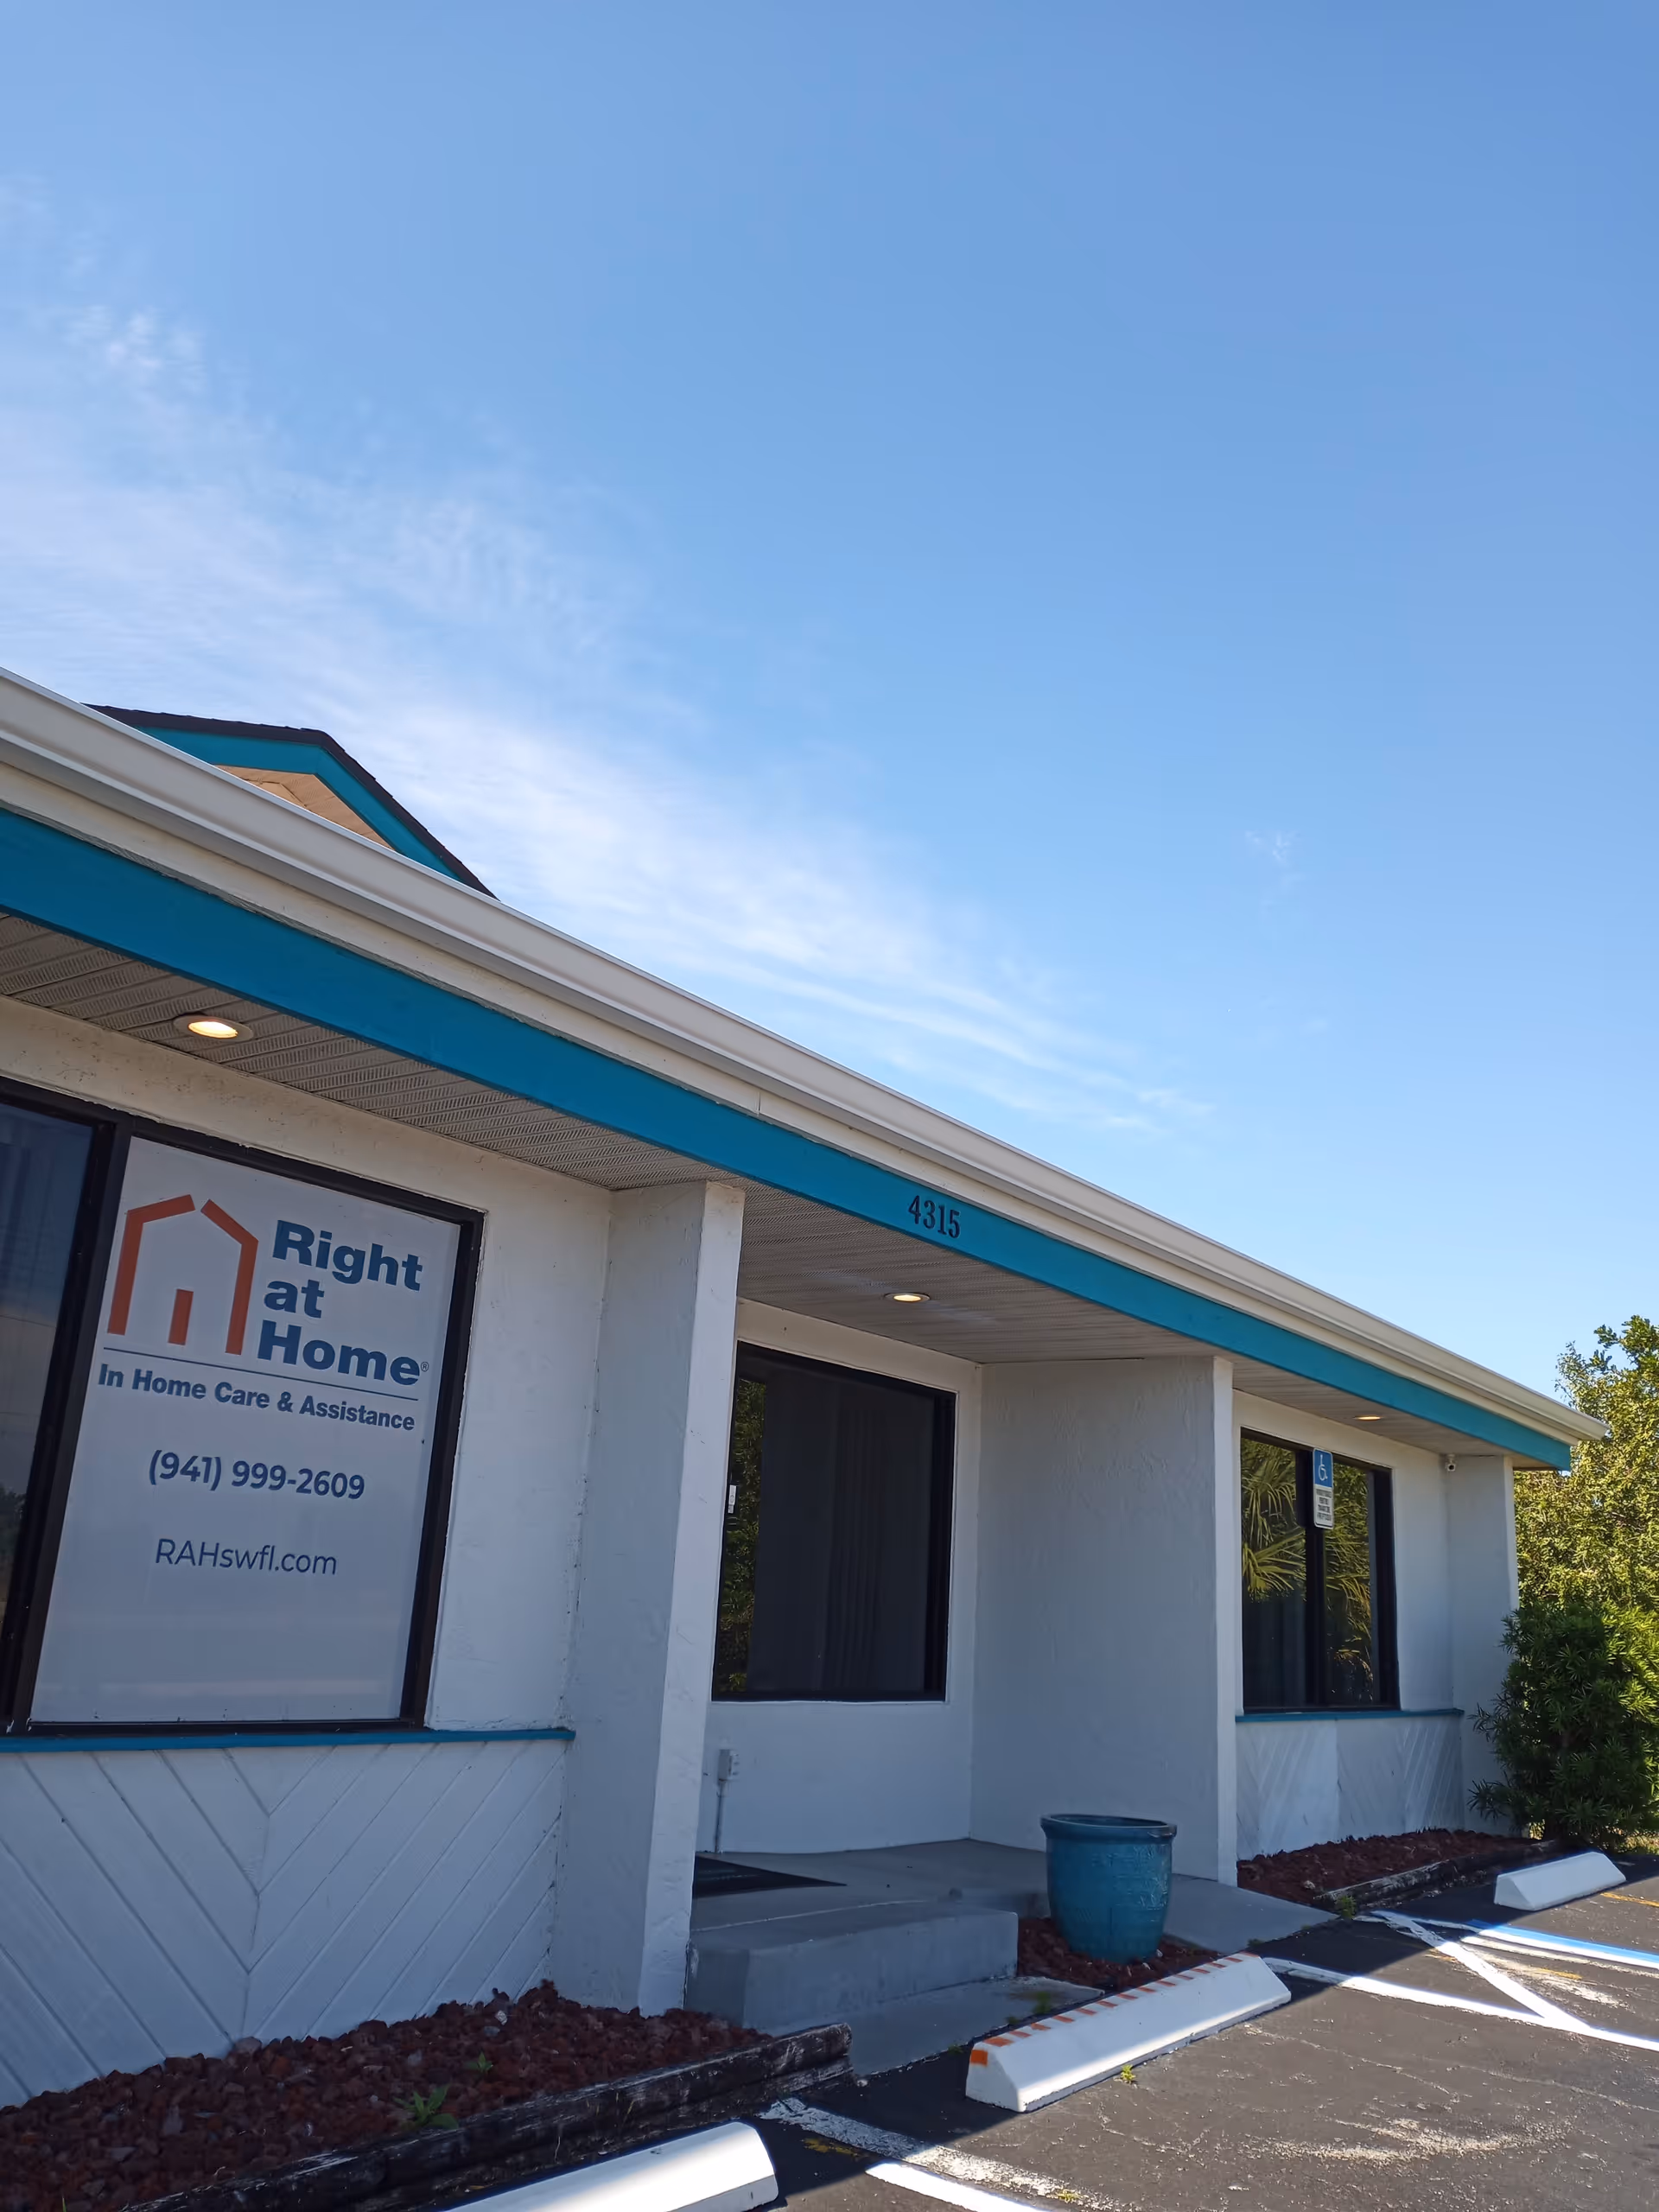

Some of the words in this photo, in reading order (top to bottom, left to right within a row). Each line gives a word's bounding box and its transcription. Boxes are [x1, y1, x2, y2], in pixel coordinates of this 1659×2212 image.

[908, 1195, 960, 1239] 4315
[272, 1219, 423, 1292] Right
[264, 1279, 325, 1319] at
[98, 1363, 124, 1388] In
[131, 1368, 207, 1400] Home
[214, 1382, 270, 1409] Care
[276, 1391, 294, 1413] &
[298, 1395, 415, 1431] Assistance
[149, 1449, 222, 1491] (941)
[231, 1460, 365, 1500] 999-2609
[155, 1538, 337, 1575] RAHswfl.com
